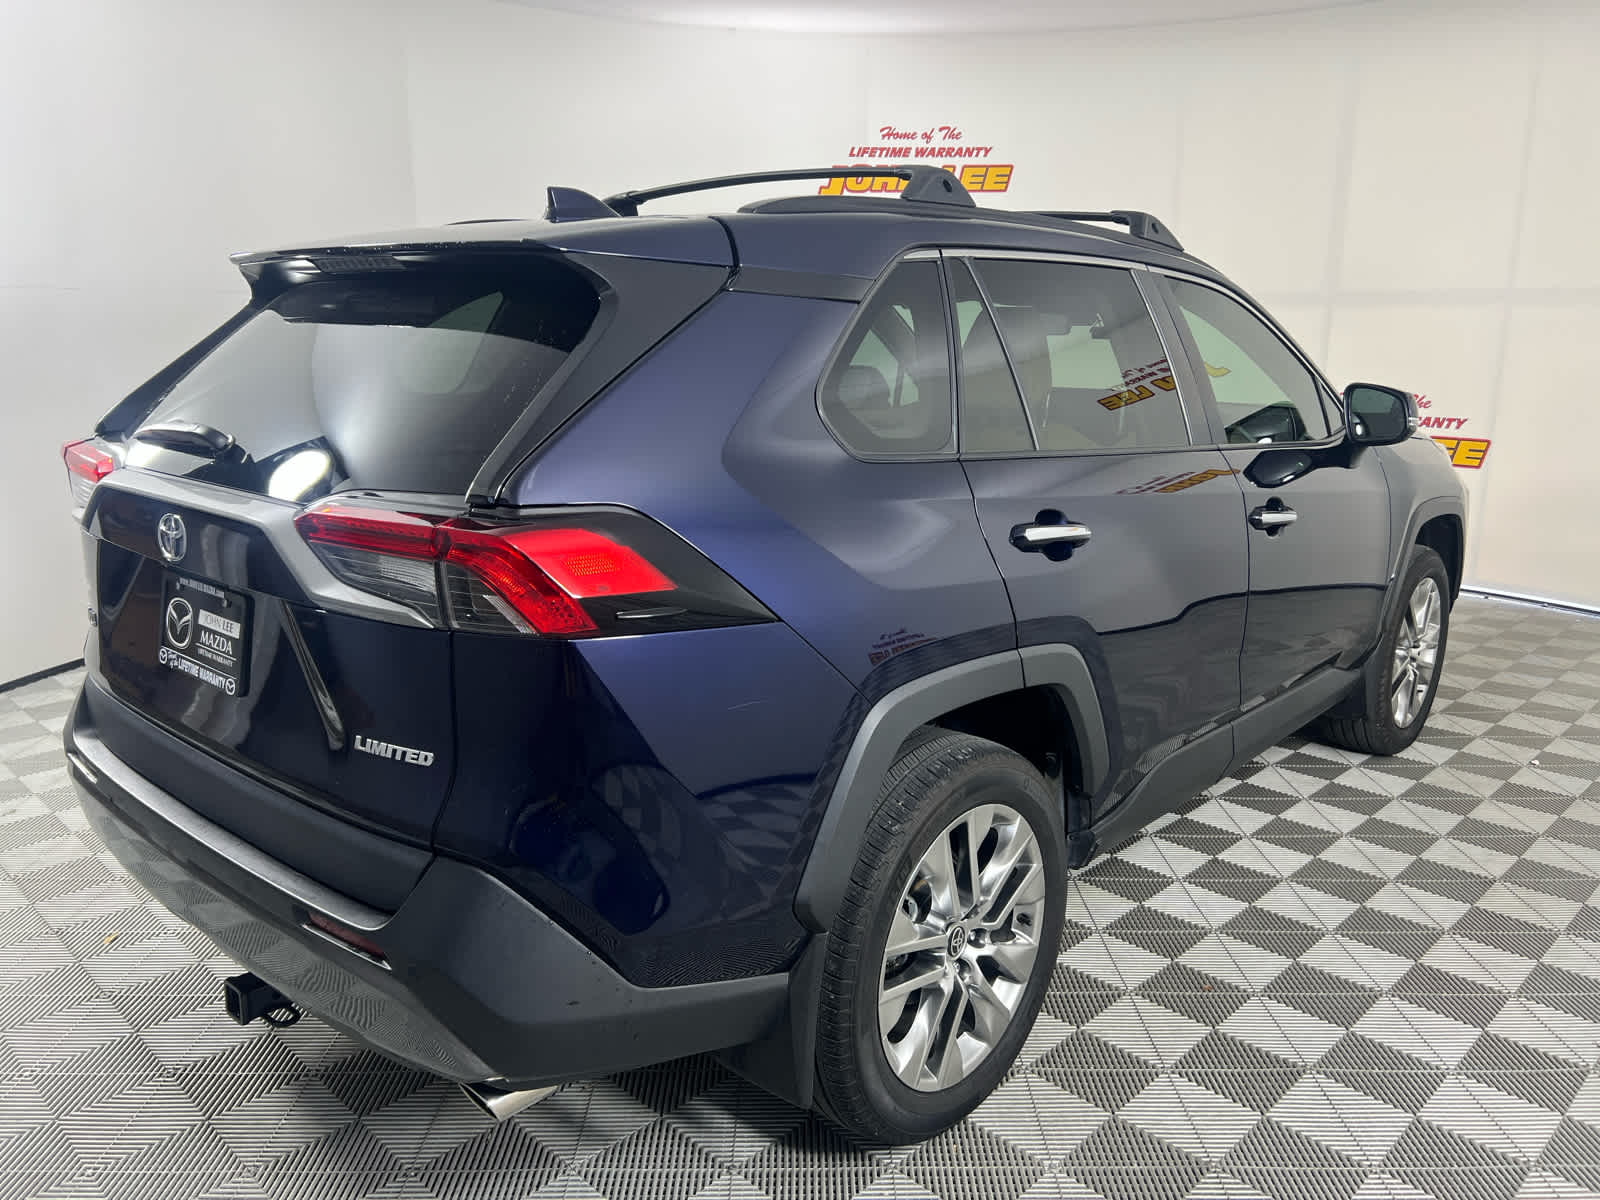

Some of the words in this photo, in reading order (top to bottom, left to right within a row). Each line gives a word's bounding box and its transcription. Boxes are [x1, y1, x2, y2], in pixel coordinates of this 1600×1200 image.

[880, 126, 917, 140] Home
[921, 128, 935, 144] of
[938, 126, 962, 140] The
[848, 146, 912, 157] LIFETIME
[914, 146, 993, 157] WARRANTY
[818, 163, 909, 195] JOH
[942, 165, 1014, 192] EE
[1413, 393, 1432, 409] he
[222, 620, 234, 633] LEE
[199, 630, 232, 655] MAZDA
[353, 735, 434, 767] LIMITED
